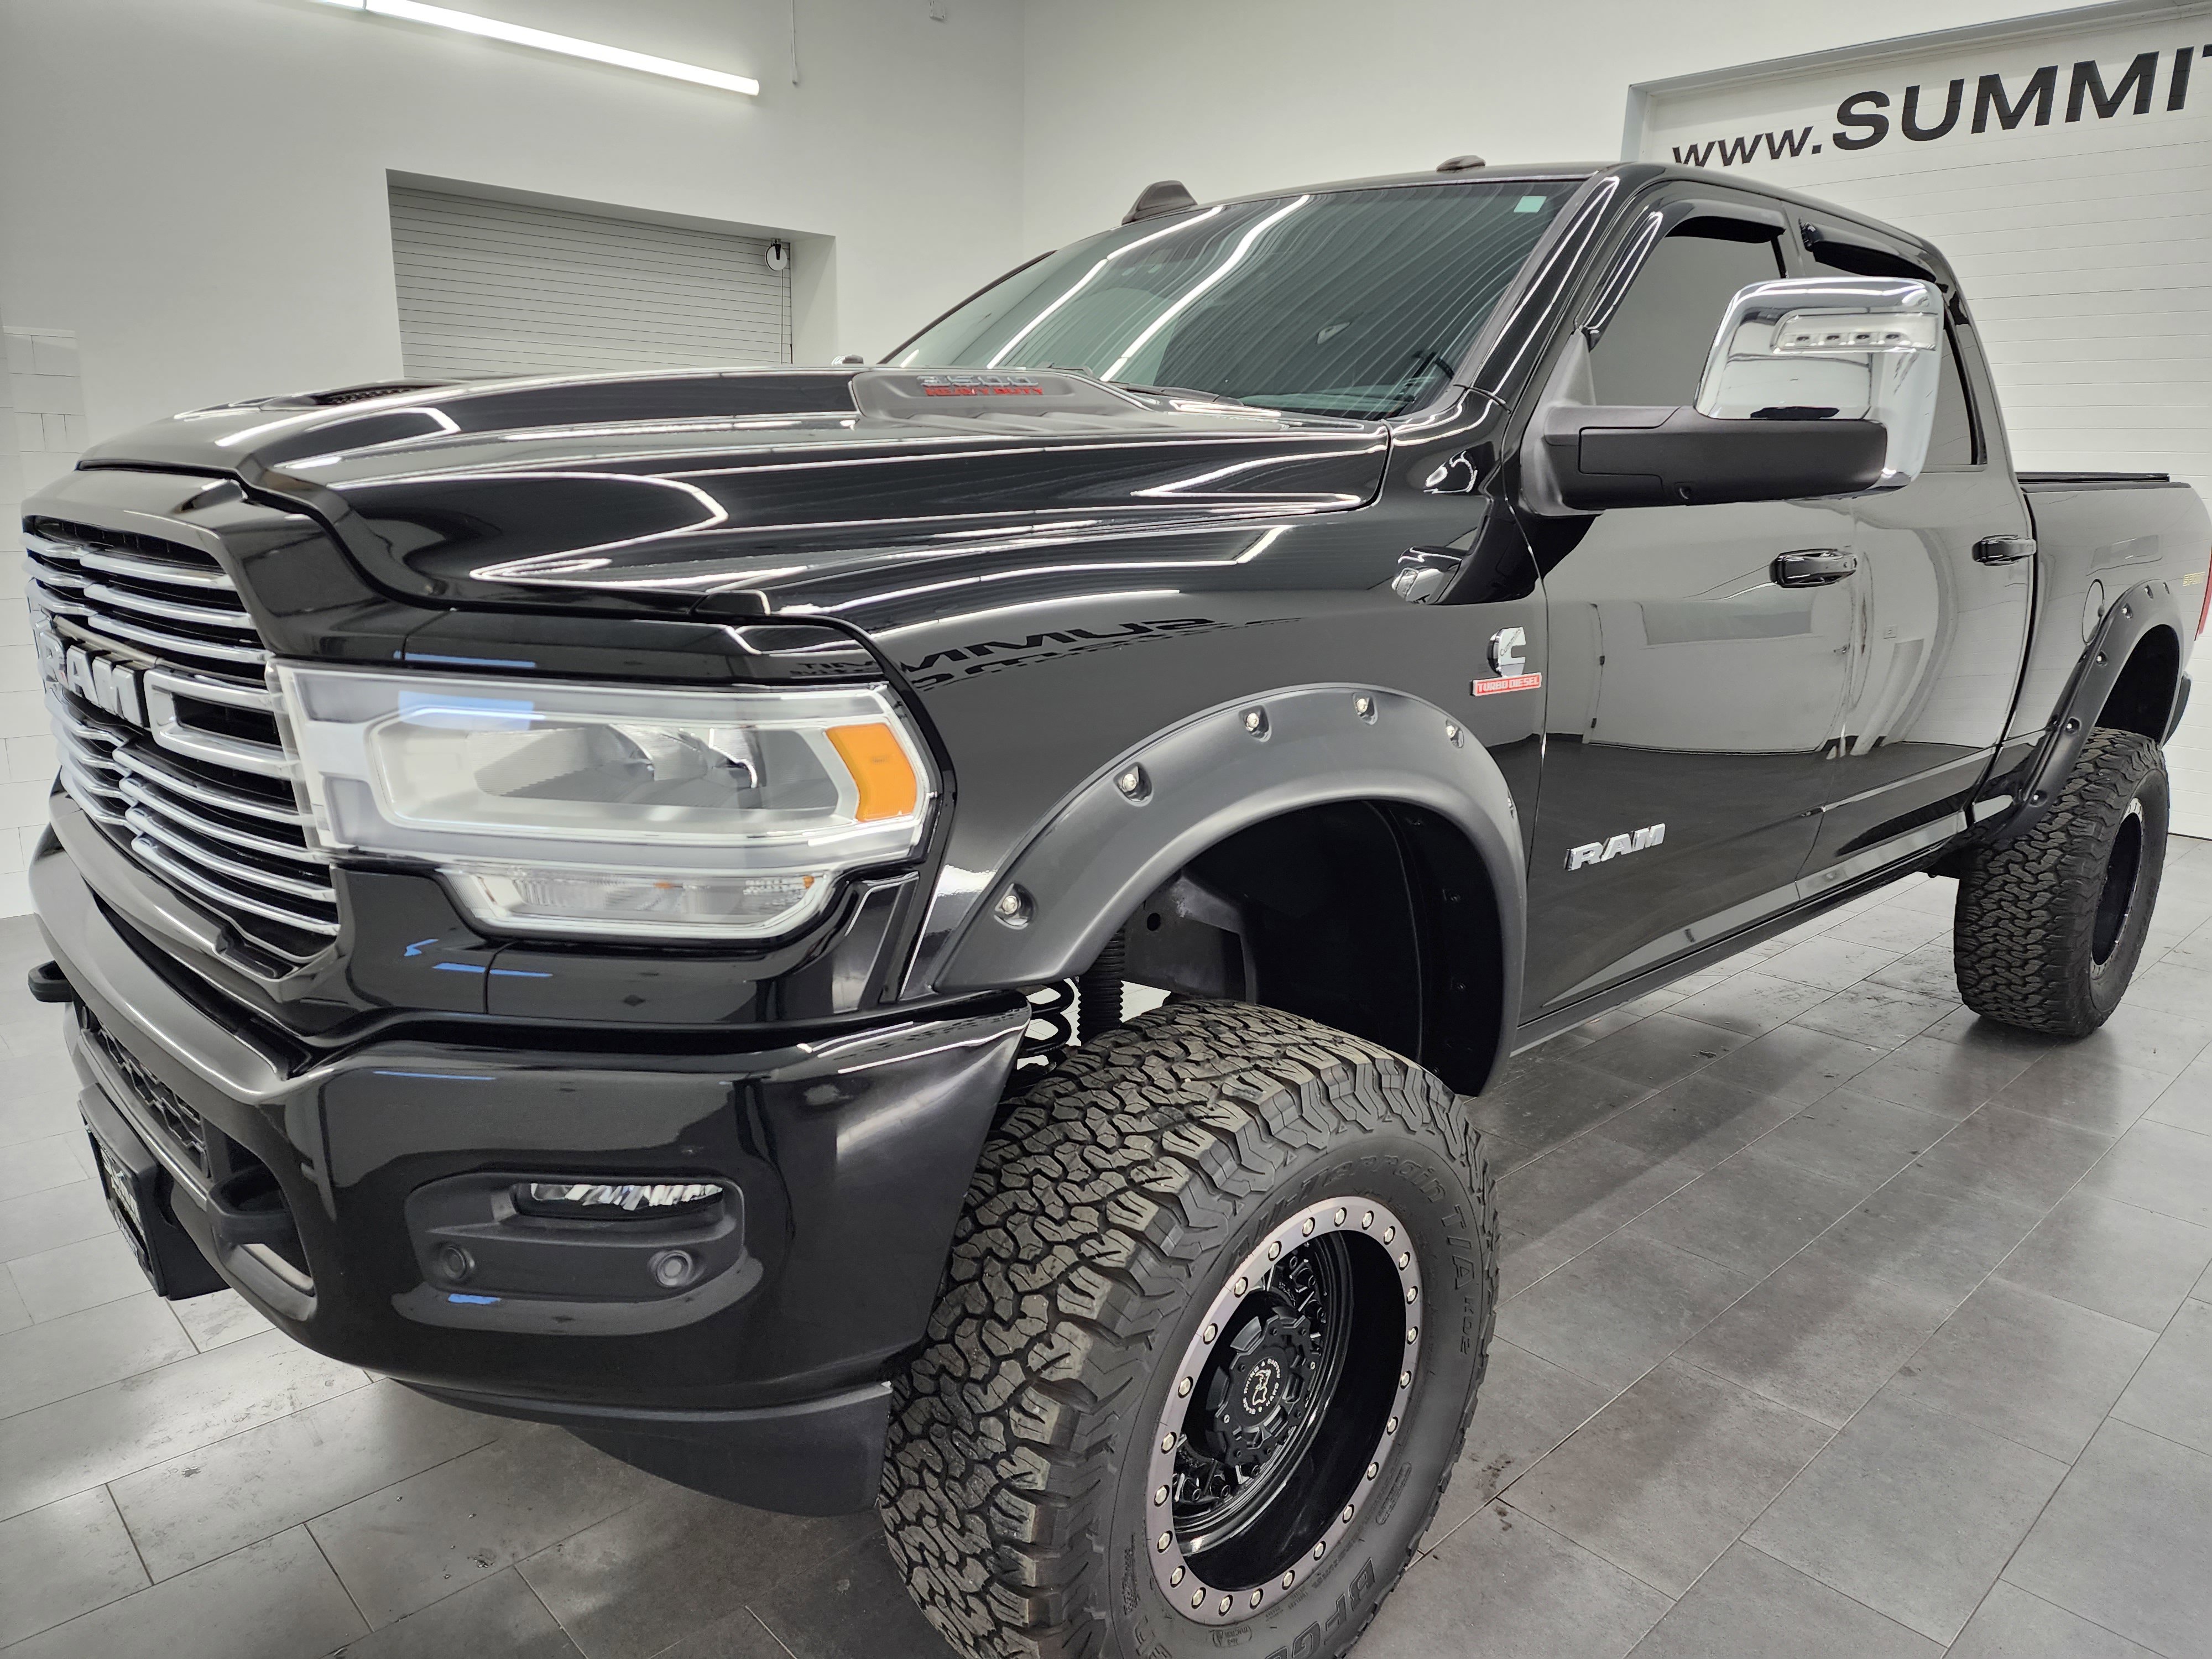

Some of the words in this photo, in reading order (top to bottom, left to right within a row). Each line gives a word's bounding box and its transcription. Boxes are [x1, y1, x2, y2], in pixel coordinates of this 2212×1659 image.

[1672, 43, 2212, 168] www.SUMMI
[38, 630, 145, 728] RAM
[1477, 679, 1509, 692] TURBO
[1509, 676, 1539, 688] DIESEL
[1565, 823, 1666, 872] RAM
[1243, 1365, 1259, 1394] RHINO
[1264, 1557, 1376, 1659] BFG
